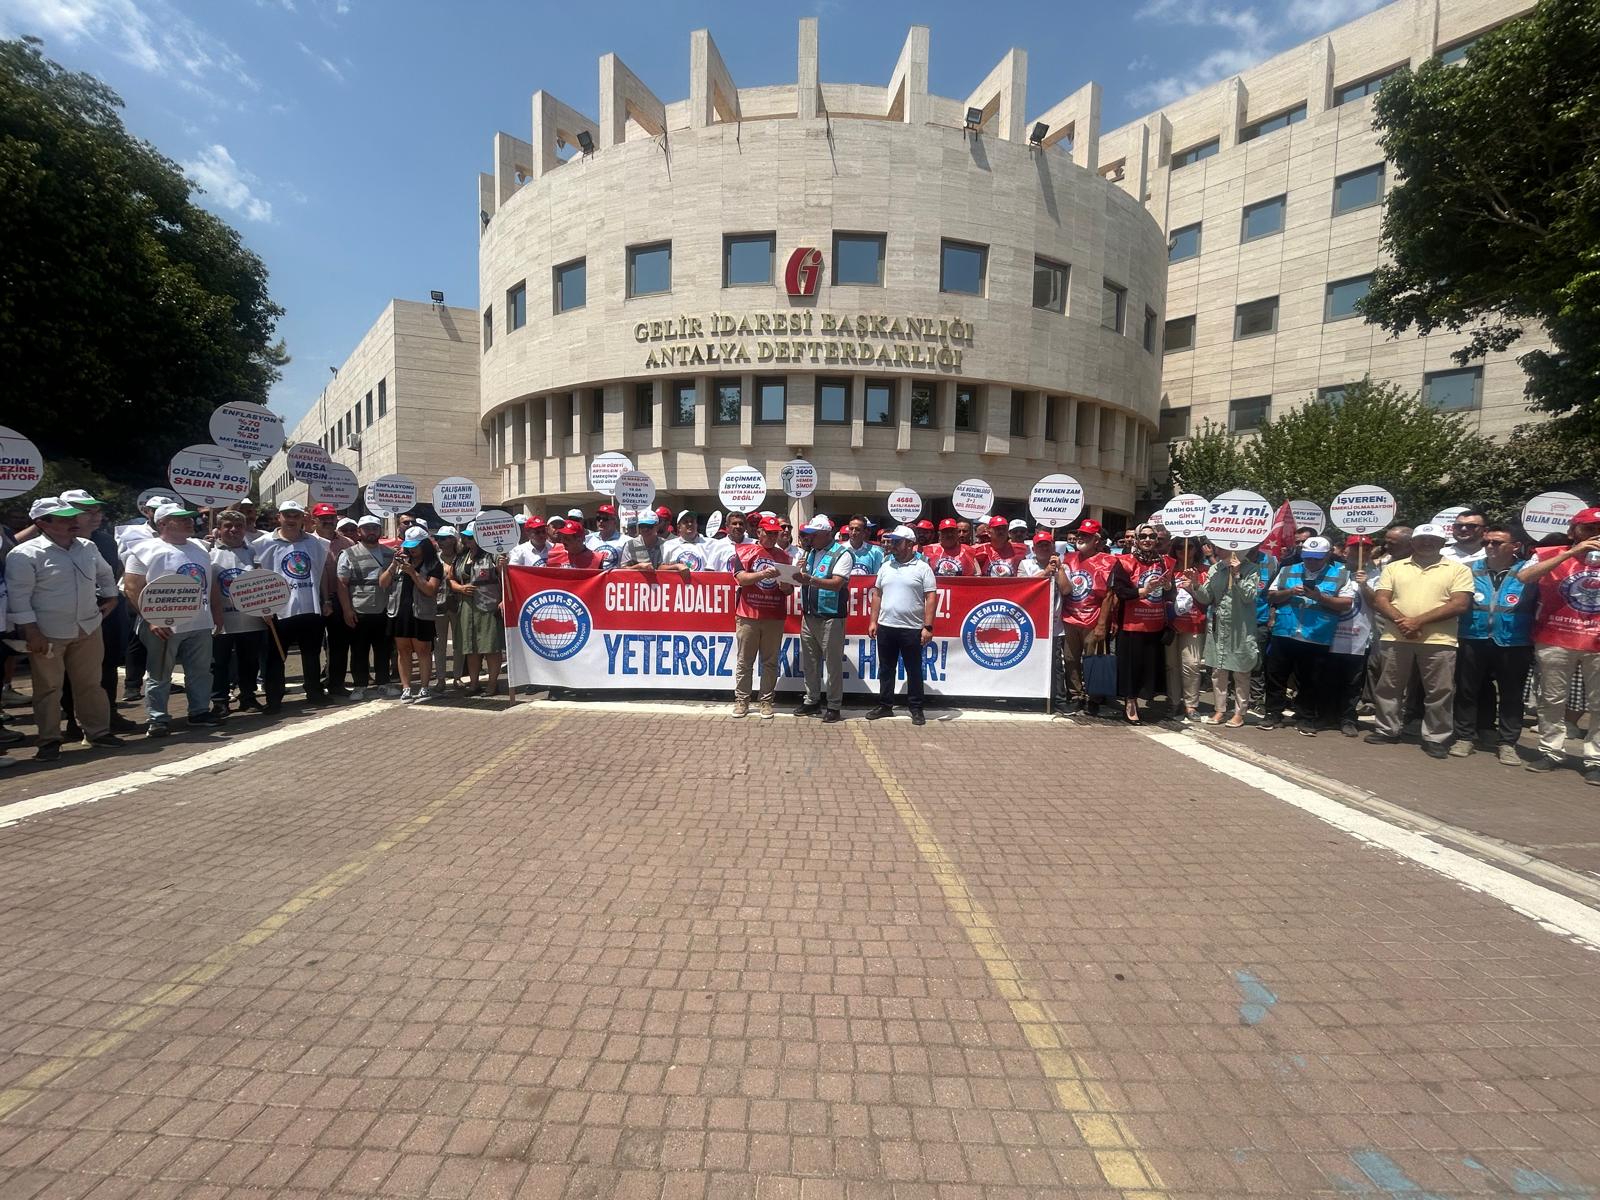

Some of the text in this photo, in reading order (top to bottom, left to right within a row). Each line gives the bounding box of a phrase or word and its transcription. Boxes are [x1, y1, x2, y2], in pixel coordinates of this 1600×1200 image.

[634, 309, 975, 343] GELİR İDARESİ BAŞKANLIĞI
[646, 341, 963, 369] ANTALYA DEFTERDARLIĞI
[222, 409, 277, 424] ENFLASYON
[239, 418, 260, 427] %70
[237, 431, 259, 439] %20
[239, 425, 259, 433] ZAM
[295, 461, 326, 471] MASA
[173, 467, 249, 484] CÜZDAN BOŞ,
[295, 470, 328, 480] VERSİN
[174, 477, 248, 493] SABIR TAŞ!
[441, 486, 472, 494] ÇALIŞANIN
[1337, 496, 1387, 504] İŞVEREN;
[1209, 504, 1269, 518] 3+1 mi,
[1209, 516, 1266, 526] AYRILIĞIN
[1342, 516, 1378, 524] (EMEKLİ)
[1526, 514, 1570, 526] BİLİM OLM
[232, 586, 264, 598] YENİLEN
[265, 580, 286, 590] DEĞİL
[236, 577, 277, 590] ENFLASYONA
[177, 586, 200, 595] ŞİMDİ
[240, 589, 280, 602] ENFLASYONU
[241, 593, 286, 608] YENEN ZAM!
[526, 594, 584, 616] MEMUR-SEN
[674, 584, 731, 614] ADALET
[970, 604, 1027, 625] MEMUR-SEN
[603, 634, 734, 677] YETERSİZ
